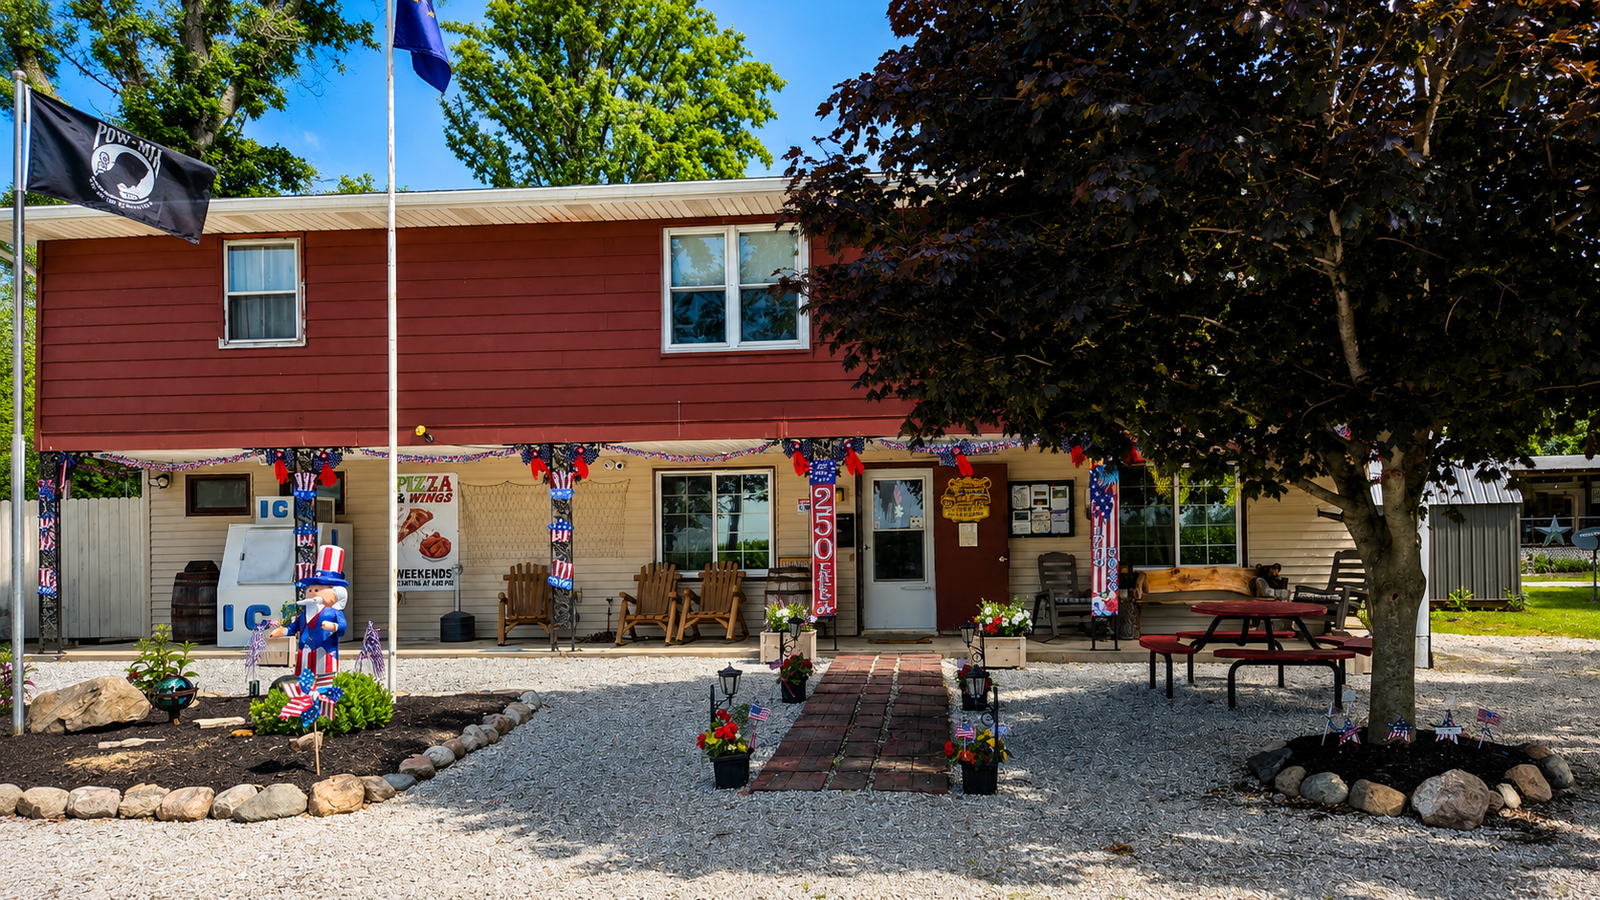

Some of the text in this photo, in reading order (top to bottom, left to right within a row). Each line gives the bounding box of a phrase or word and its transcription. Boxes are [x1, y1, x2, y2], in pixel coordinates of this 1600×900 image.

[397, 475, 453, 492] PIZZA
[409, 493, 453, 503] WINGS
[260, 500, 288, 518] IC
[397, 568, 452, 579] WEEKENDS
